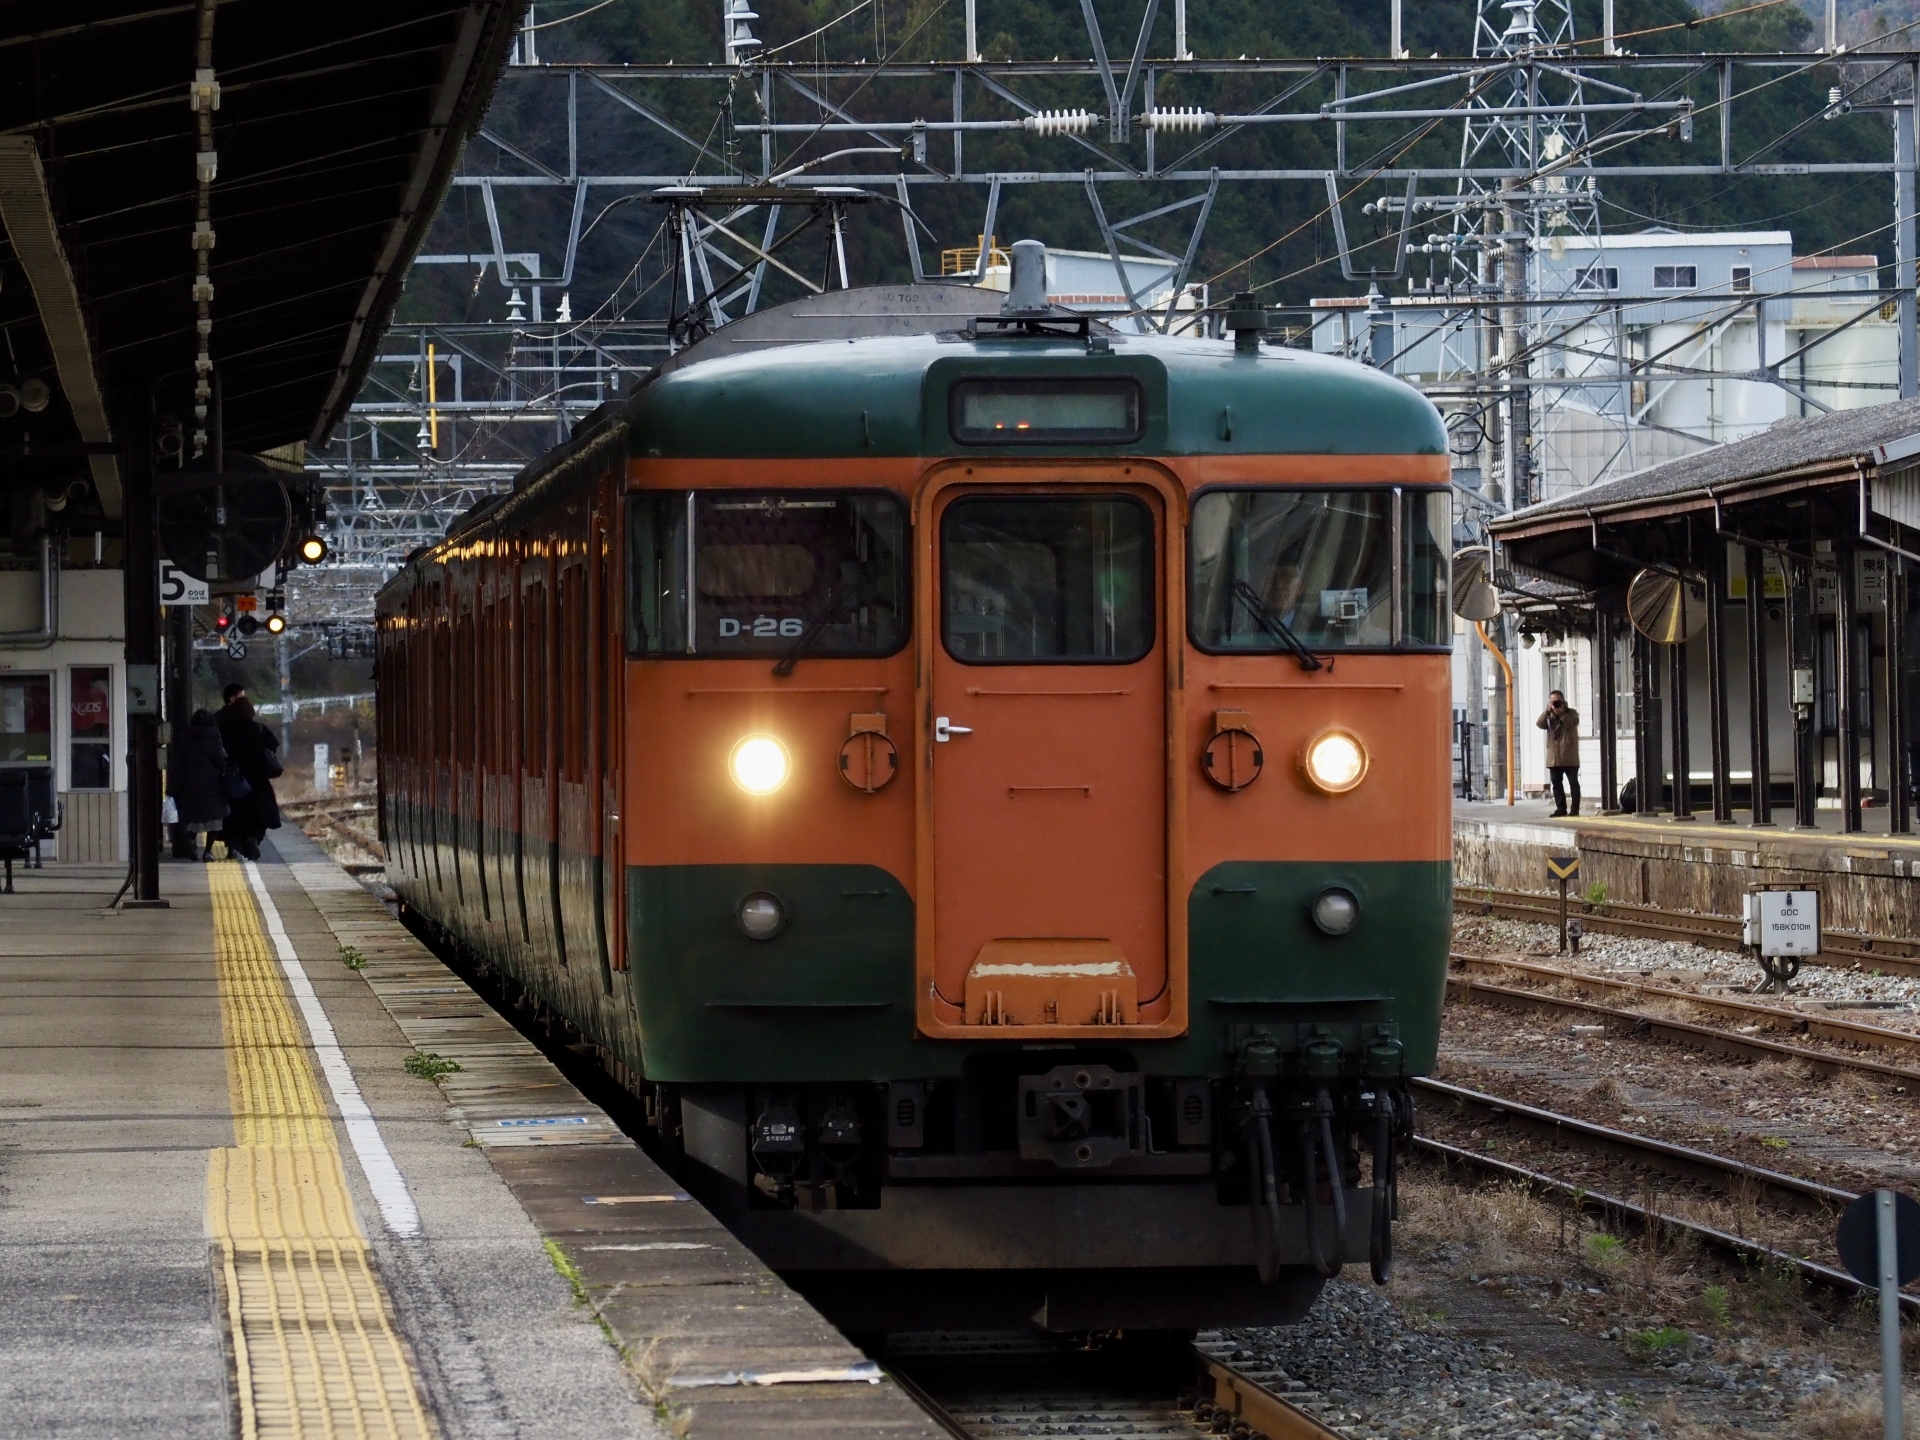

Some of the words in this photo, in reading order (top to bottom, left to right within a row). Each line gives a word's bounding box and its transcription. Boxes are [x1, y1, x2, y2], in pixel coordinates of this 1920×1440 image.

[162, 565, 184, 601] 5
[1819, 596, 1825, 604] 2
[1867, 595, 1871, 603] 1
[228, 627, 237, 640] 4
[719, 618, 803, 637] D-26
